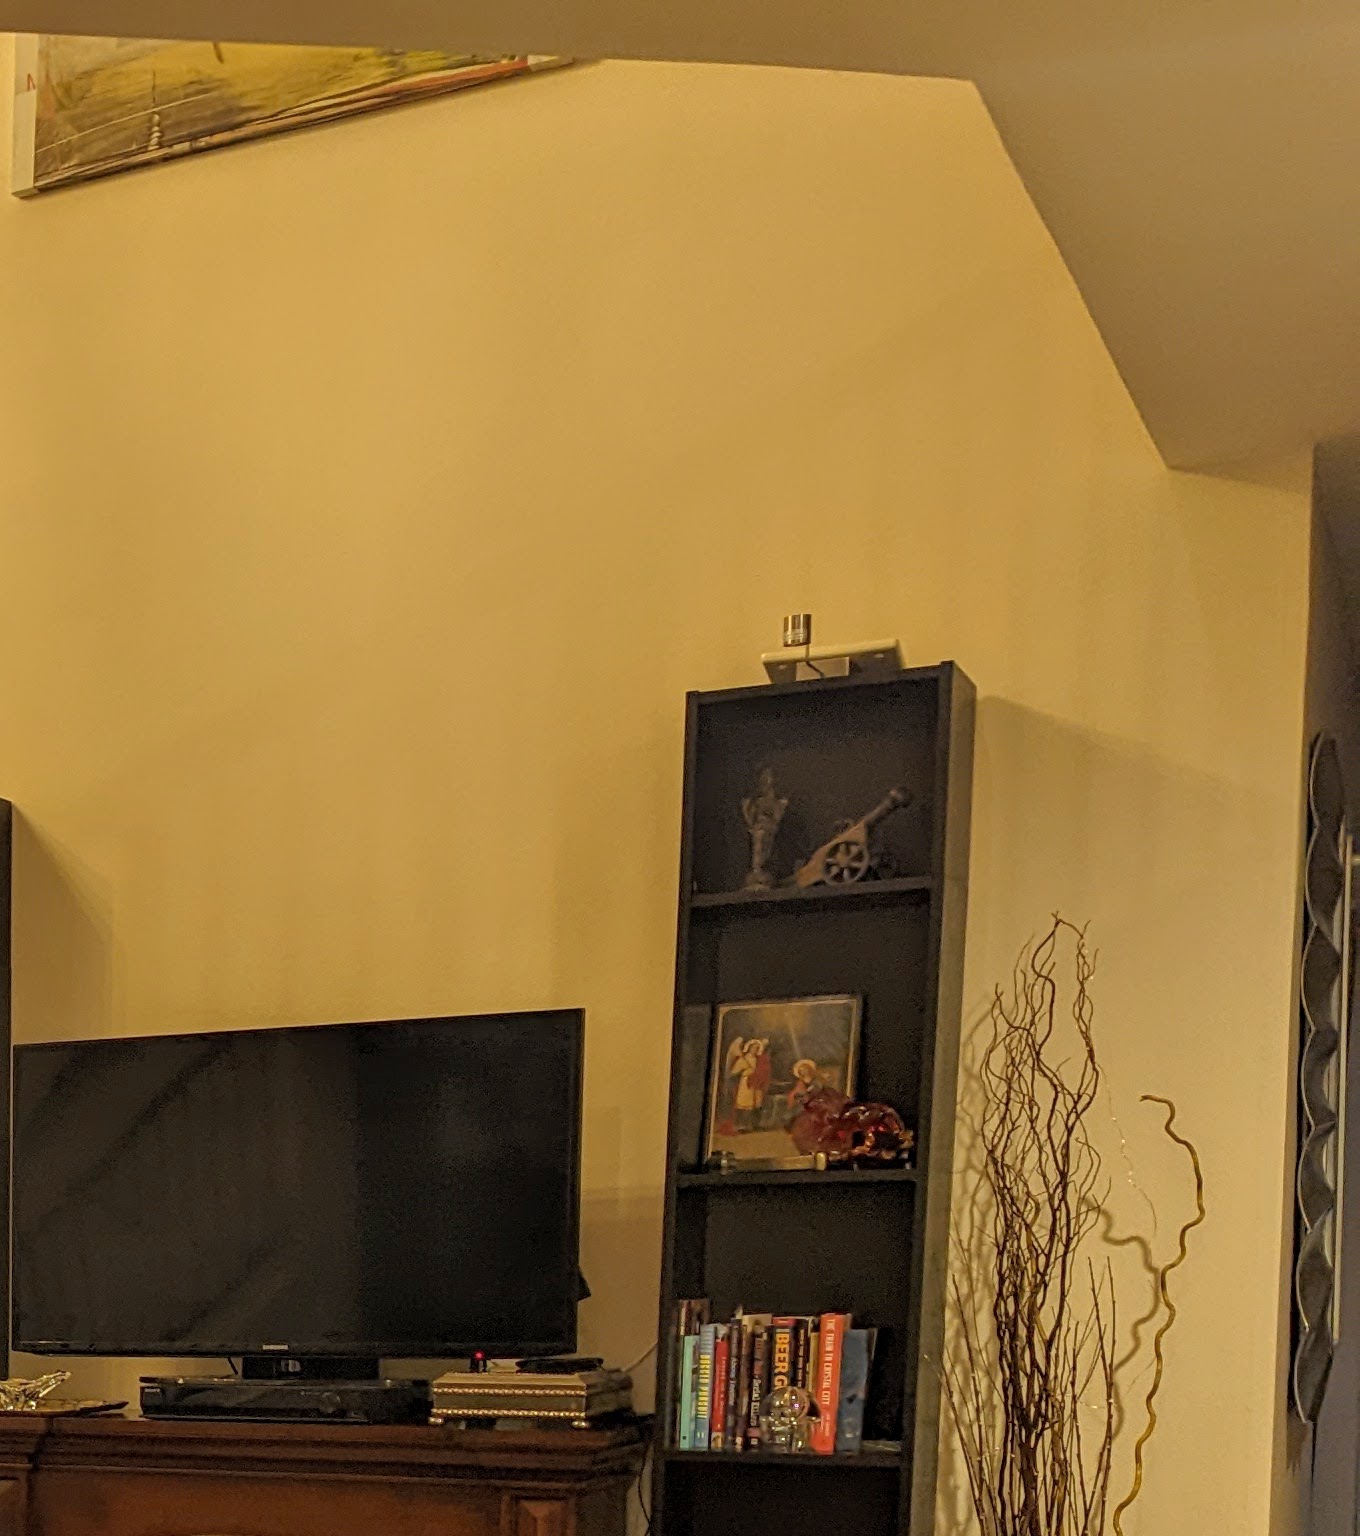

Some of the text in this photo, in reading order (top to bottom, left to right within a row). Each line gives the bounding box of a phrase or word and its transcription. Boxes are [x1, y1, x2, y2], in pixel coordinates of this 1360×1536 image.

[774, 1333, 790, 1373] BEER
[823, 1363, 832, 1389] CRYSTAL
[822, 1391, 831, 1405] CITY
